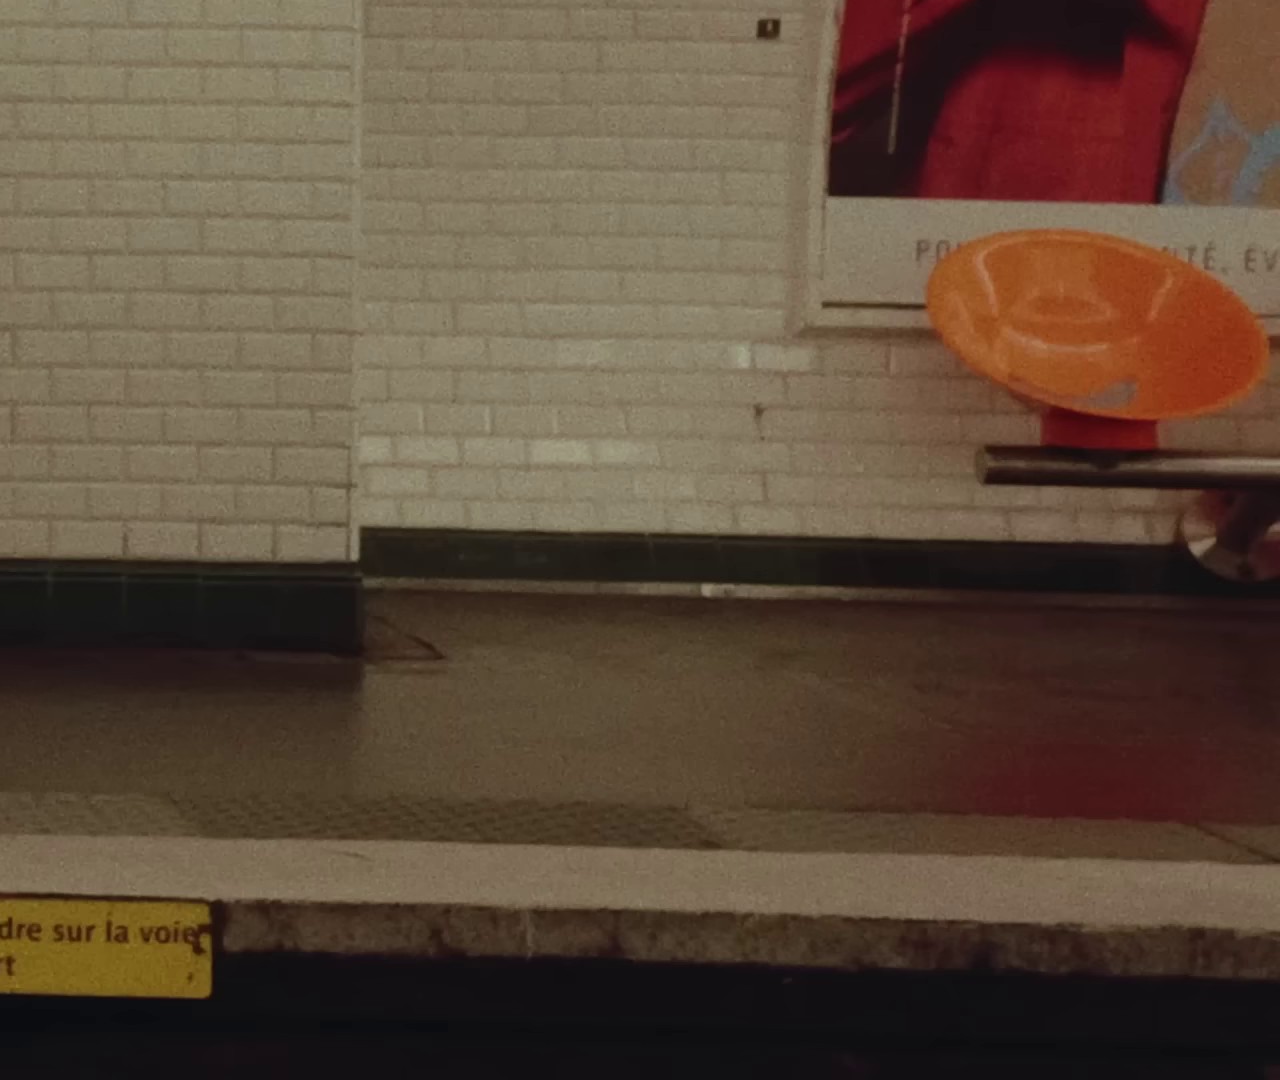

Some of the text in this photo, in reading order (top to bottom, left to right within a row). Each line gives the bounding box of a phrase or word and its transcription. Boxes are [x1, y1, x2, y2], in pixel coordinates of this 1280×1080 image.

[53, 922, 96, 943] sur
[105, 919, 130, 943] la
[140, 921, 201, 945] voie
